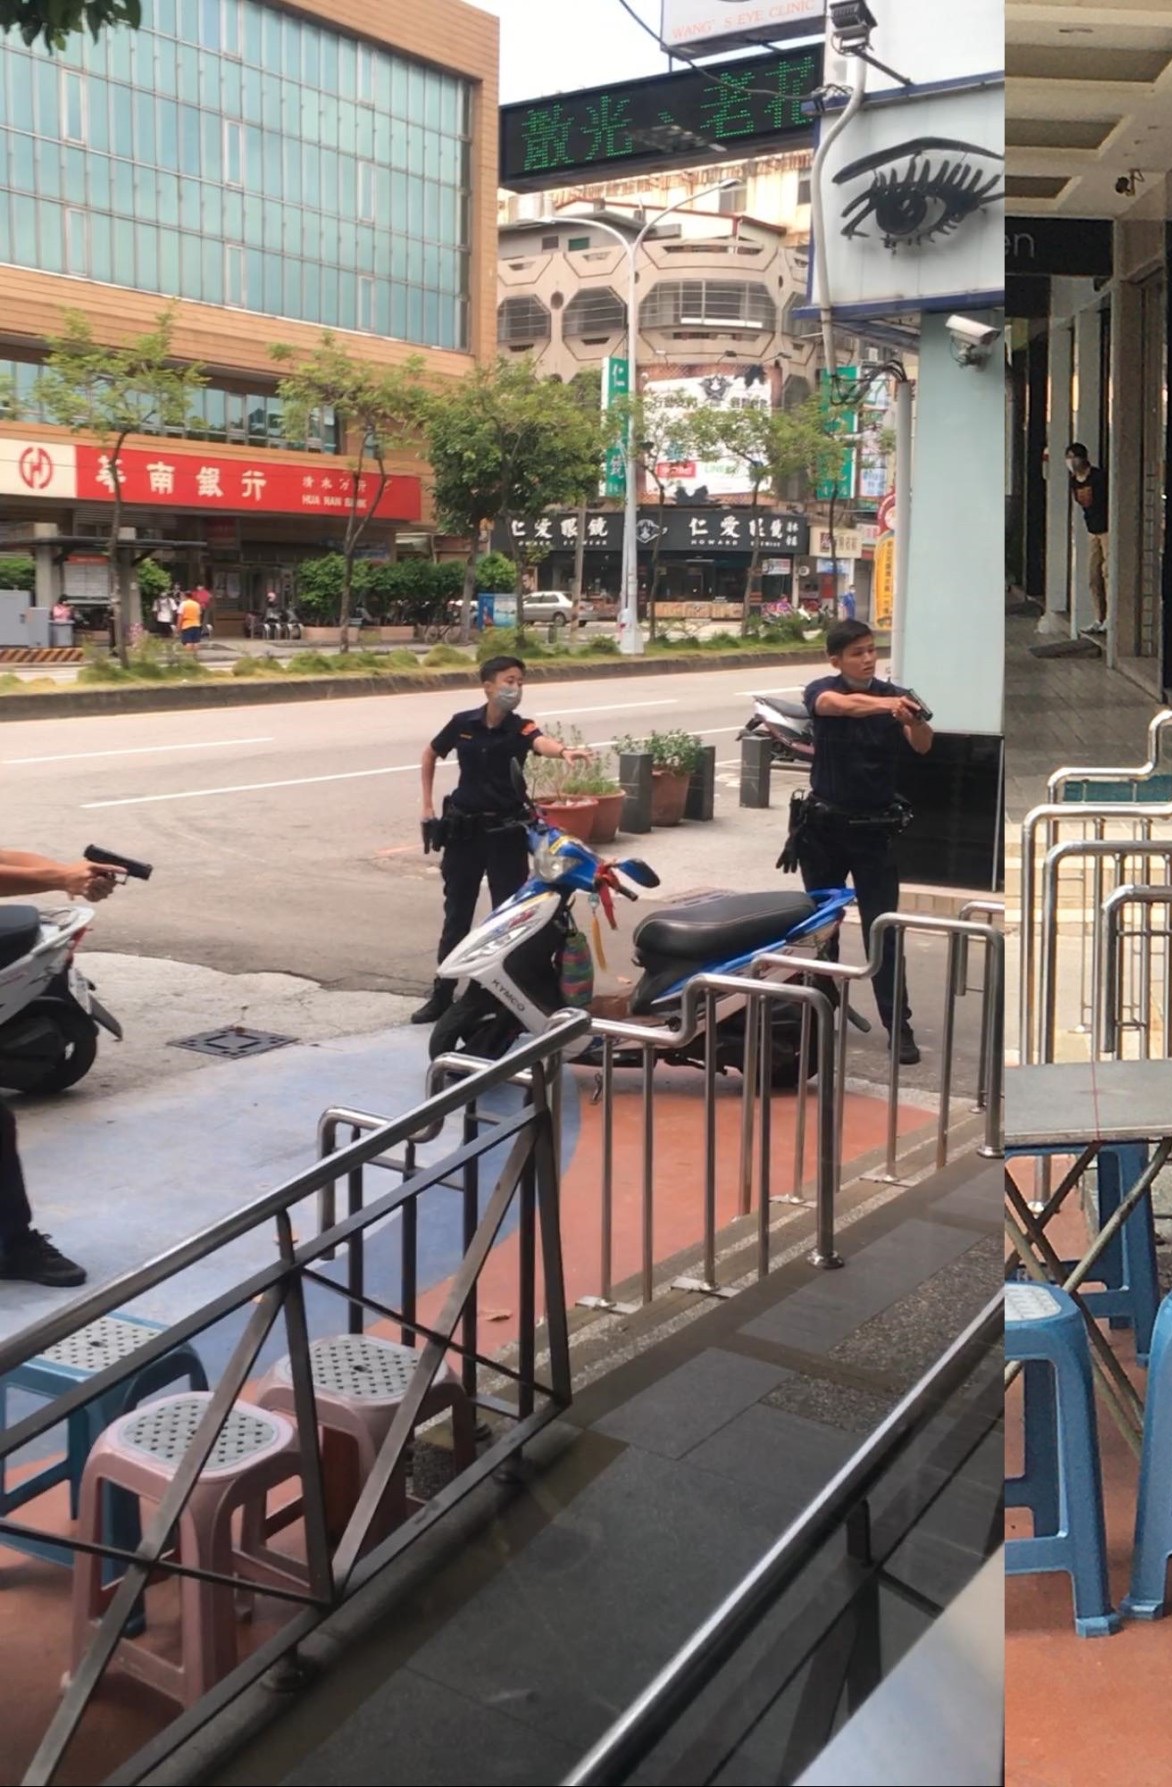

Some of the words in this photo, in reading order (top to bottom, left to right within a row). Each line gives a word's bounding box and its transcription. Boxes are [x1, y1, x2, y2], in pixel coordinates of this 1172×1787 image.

[737, 10, 764, 25] EYE
[768, 0, 816, 18] CLINIC
[491, 979, 526, 1012] KYMCO
